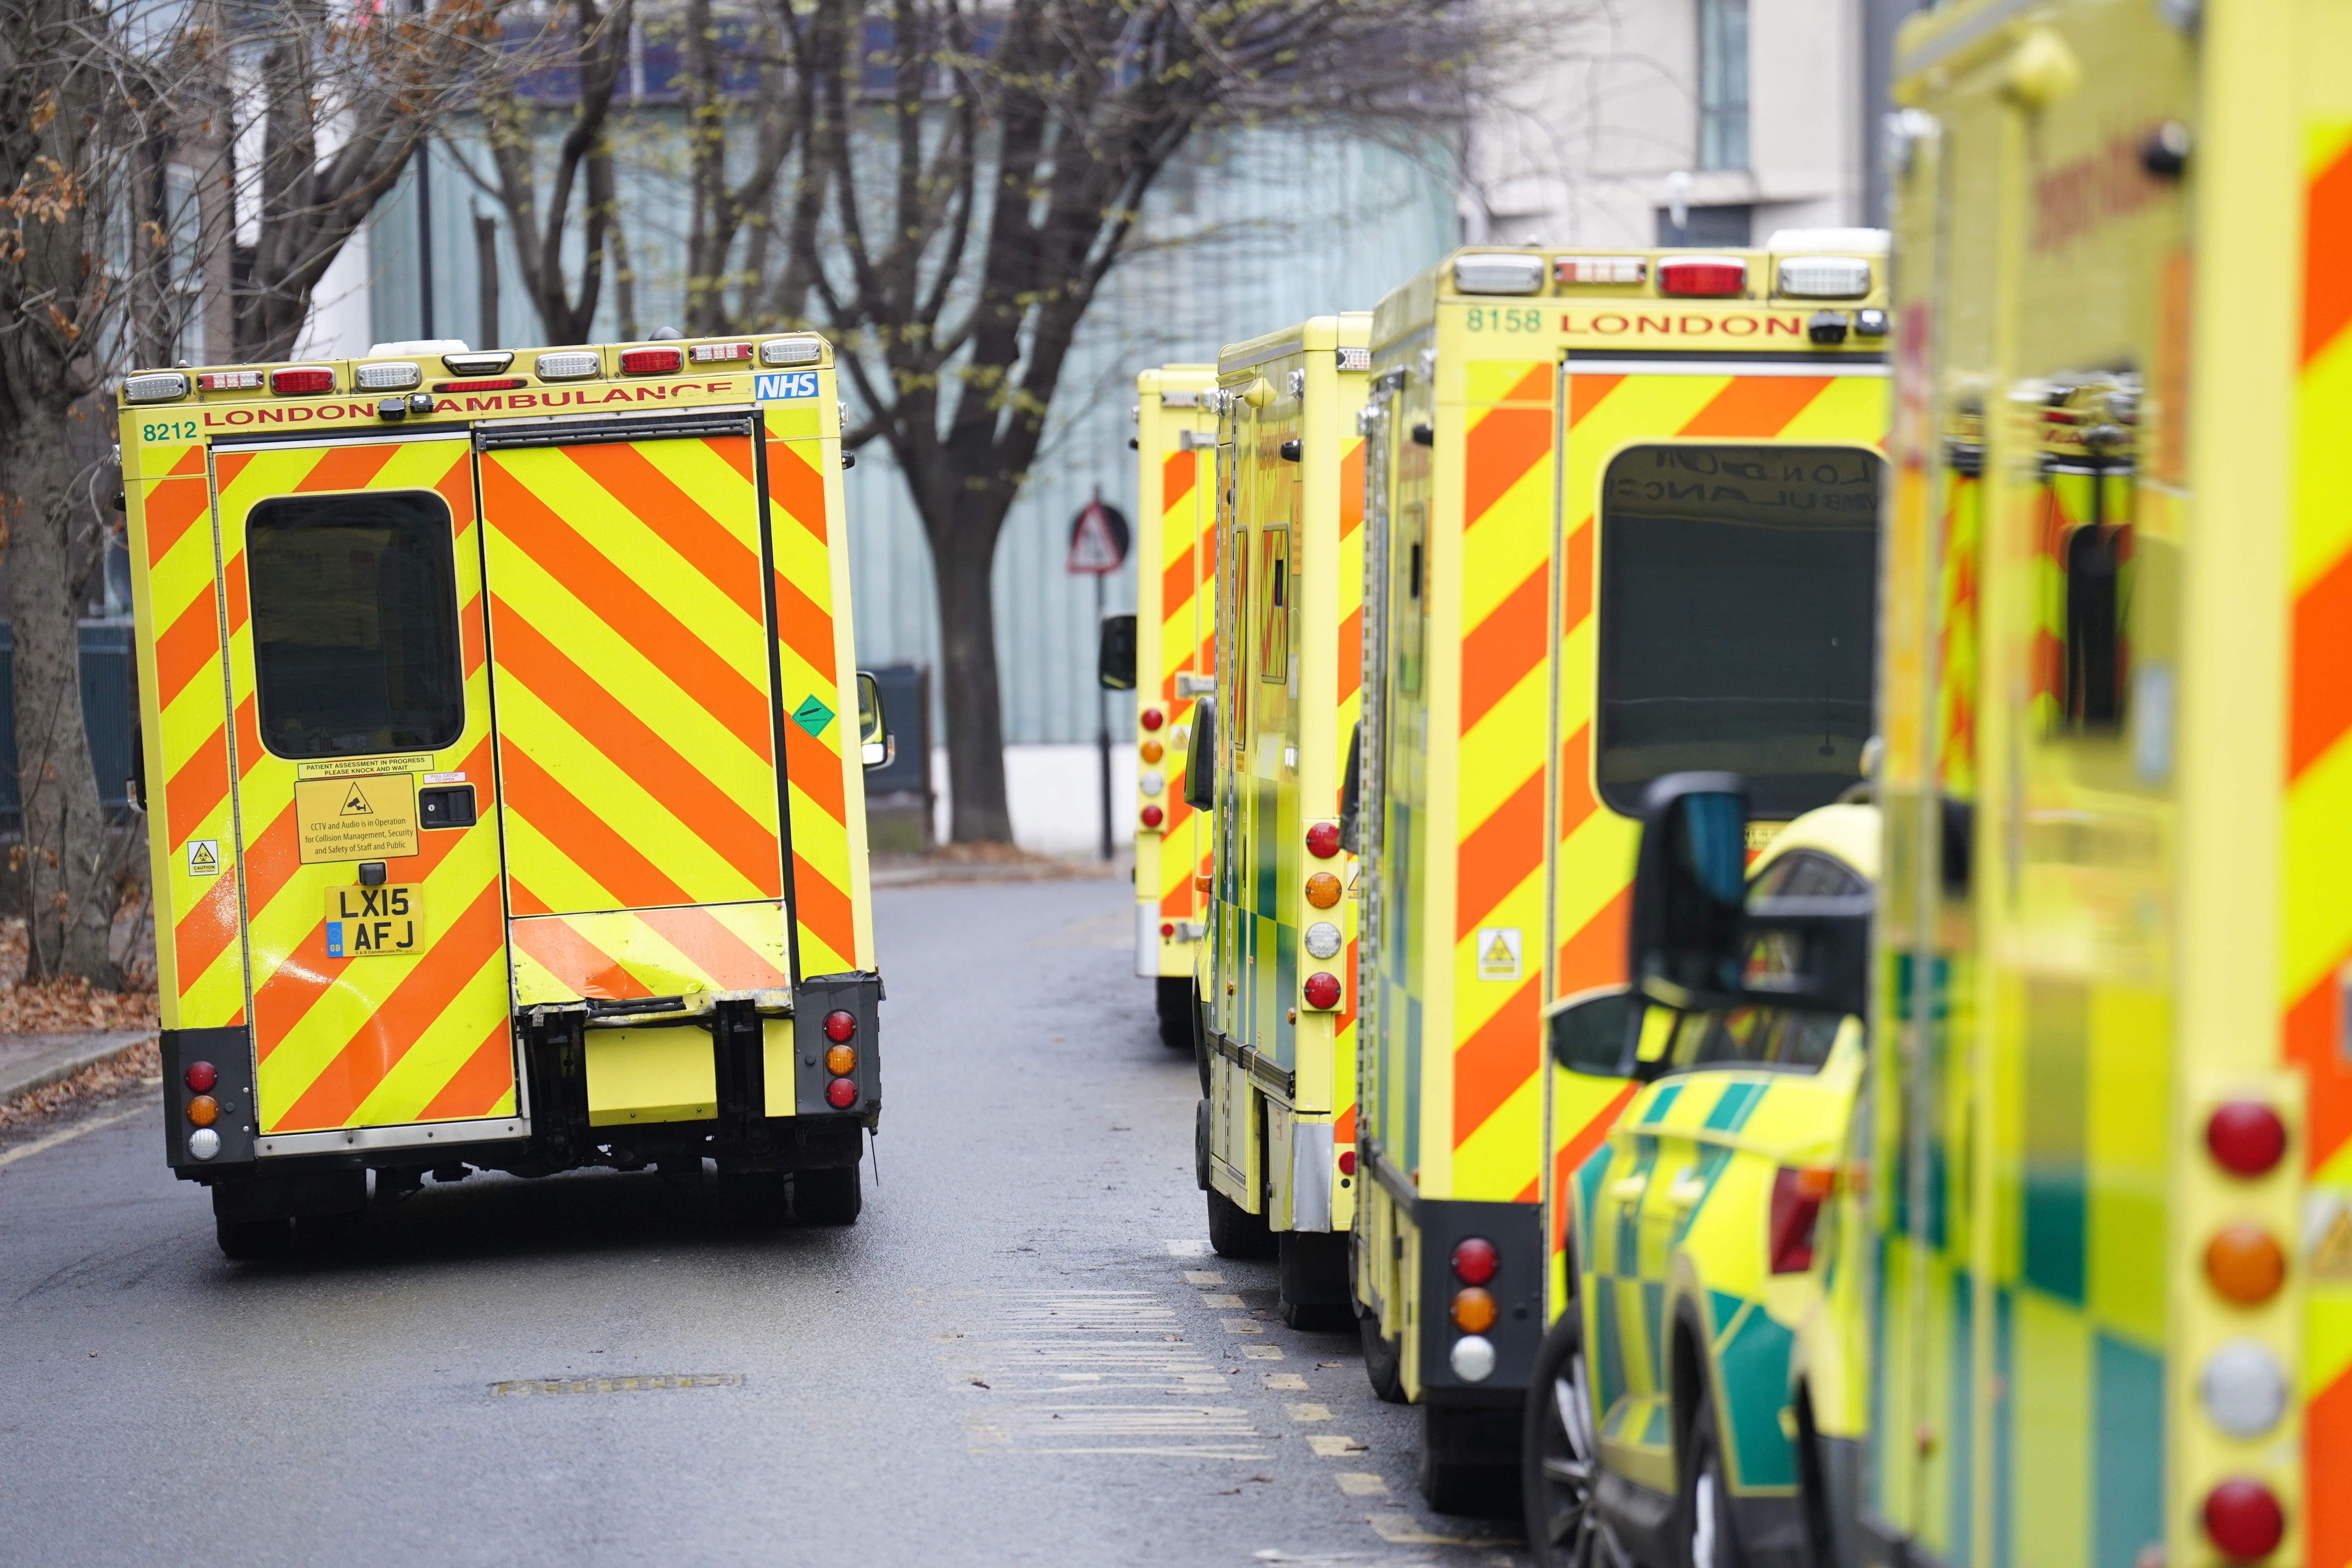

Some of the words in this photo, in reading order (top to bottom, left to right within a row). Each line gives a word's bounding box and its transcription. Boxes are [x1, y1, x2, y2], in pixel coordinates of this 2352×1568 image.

[1466, 309, 1541, 332] 8158
[1560, 314, 1801, 337] LONDON
[758, 372, 816, 398] NHS
[203, 403, 374, 426] LONDON
[143, 421, 197, 442] 8212
[311, 823, 326, 831] CCTV
[328, 821, 340, 829] and
[342, 820, 359, 828] Audio
[375, 818, 406, 828] Operation
[316, 833, 341, 842] Collision
[343, 831, 387, 841] Management,
[388, 829, 413, 837] Security
[328, 845, 348, 854] Safety
[350, 844, 356, 852] of
[358, 843, 372, 851] Staff
[373, 842, 385, 850] and
[387, 841, 406, 849] Public
[340, 888, 409, 918] LX15
